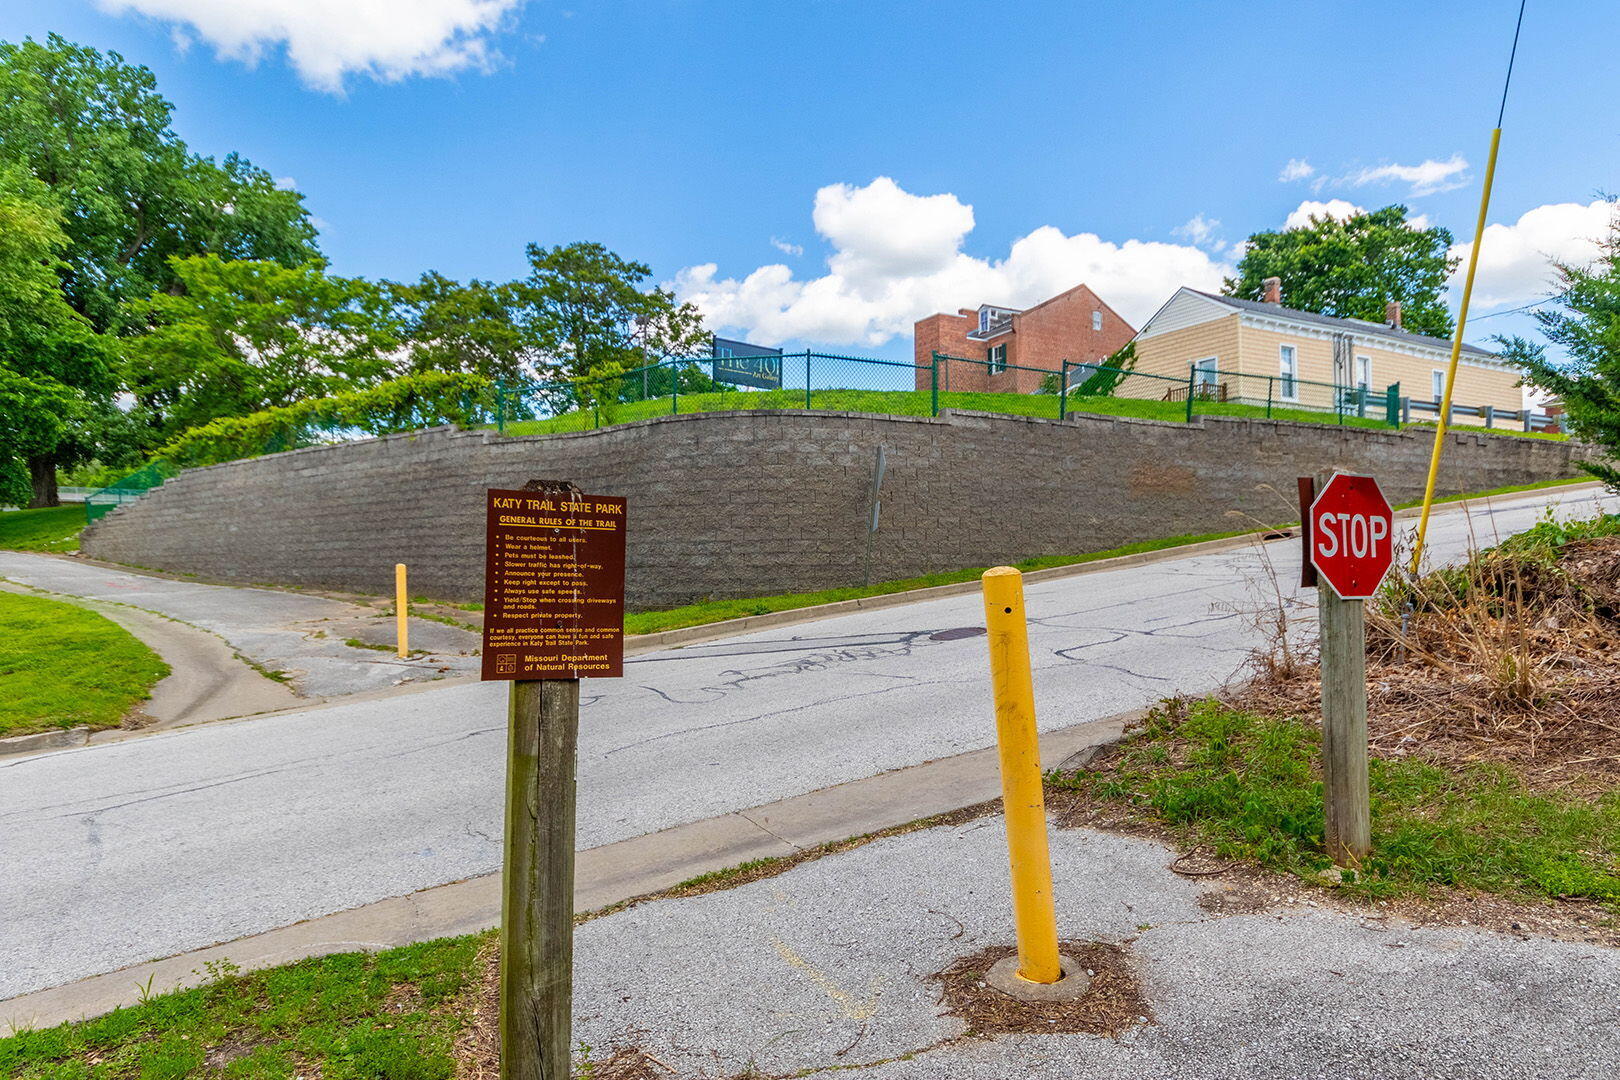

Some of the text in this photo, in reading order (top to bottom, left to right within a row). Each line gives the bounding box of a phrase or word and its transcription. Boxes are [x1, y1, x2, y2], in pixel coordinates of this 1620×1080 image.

[494, 498, 622, 514] KATY TRAIL STATE PARK
[500, 516, 536, 524] GENERAL
[596, 520, 616, 528] TRAIL
[1318, 512, 1387, 558] STOP
[562, 654, 608, 662] Department
